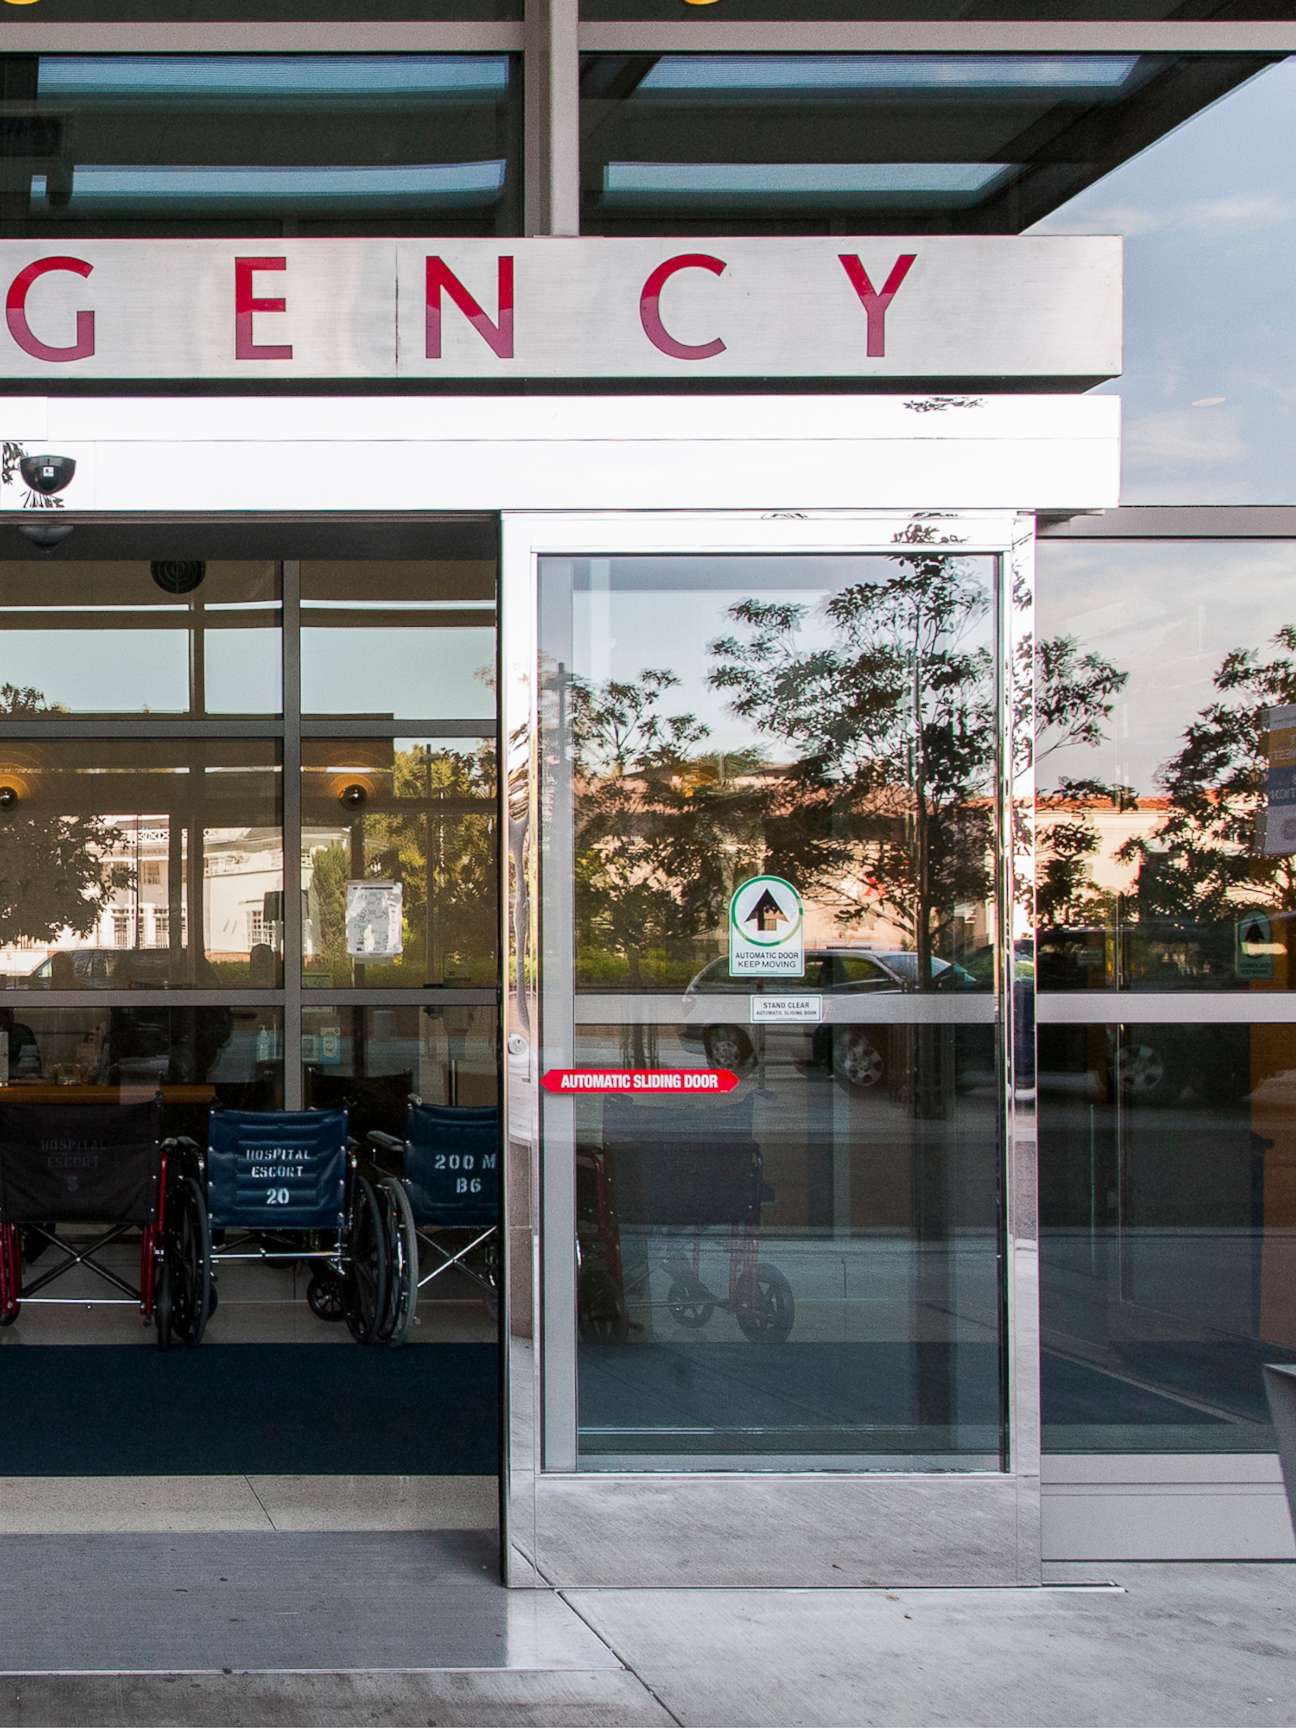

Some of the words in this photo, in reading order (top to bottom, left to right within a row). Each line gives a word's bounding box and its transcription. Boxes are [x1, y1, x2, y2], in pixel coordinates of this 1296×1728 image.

[735, 951, 776, 959] AUTOMATIC
[737, 960, 761, 968] KEEP
[761, 960, 797, 968] MOVING
[762, 1001, 786, 1009] STAND
[787, 1001, 810, 1009] CLEAR
[560, 1074, 631, 1089] AUTOMATIC
[633, 1074, 681, 1088] SLIDING
[683, 1074, 718, 1088] DOOR
[245, 1147, 311, 1161] HOSPITAL
[434, 1154, 474, 1170] 200
[250, 1166, 304, 1178] ESCORT
[266, 1187, 290, 1204] 20
